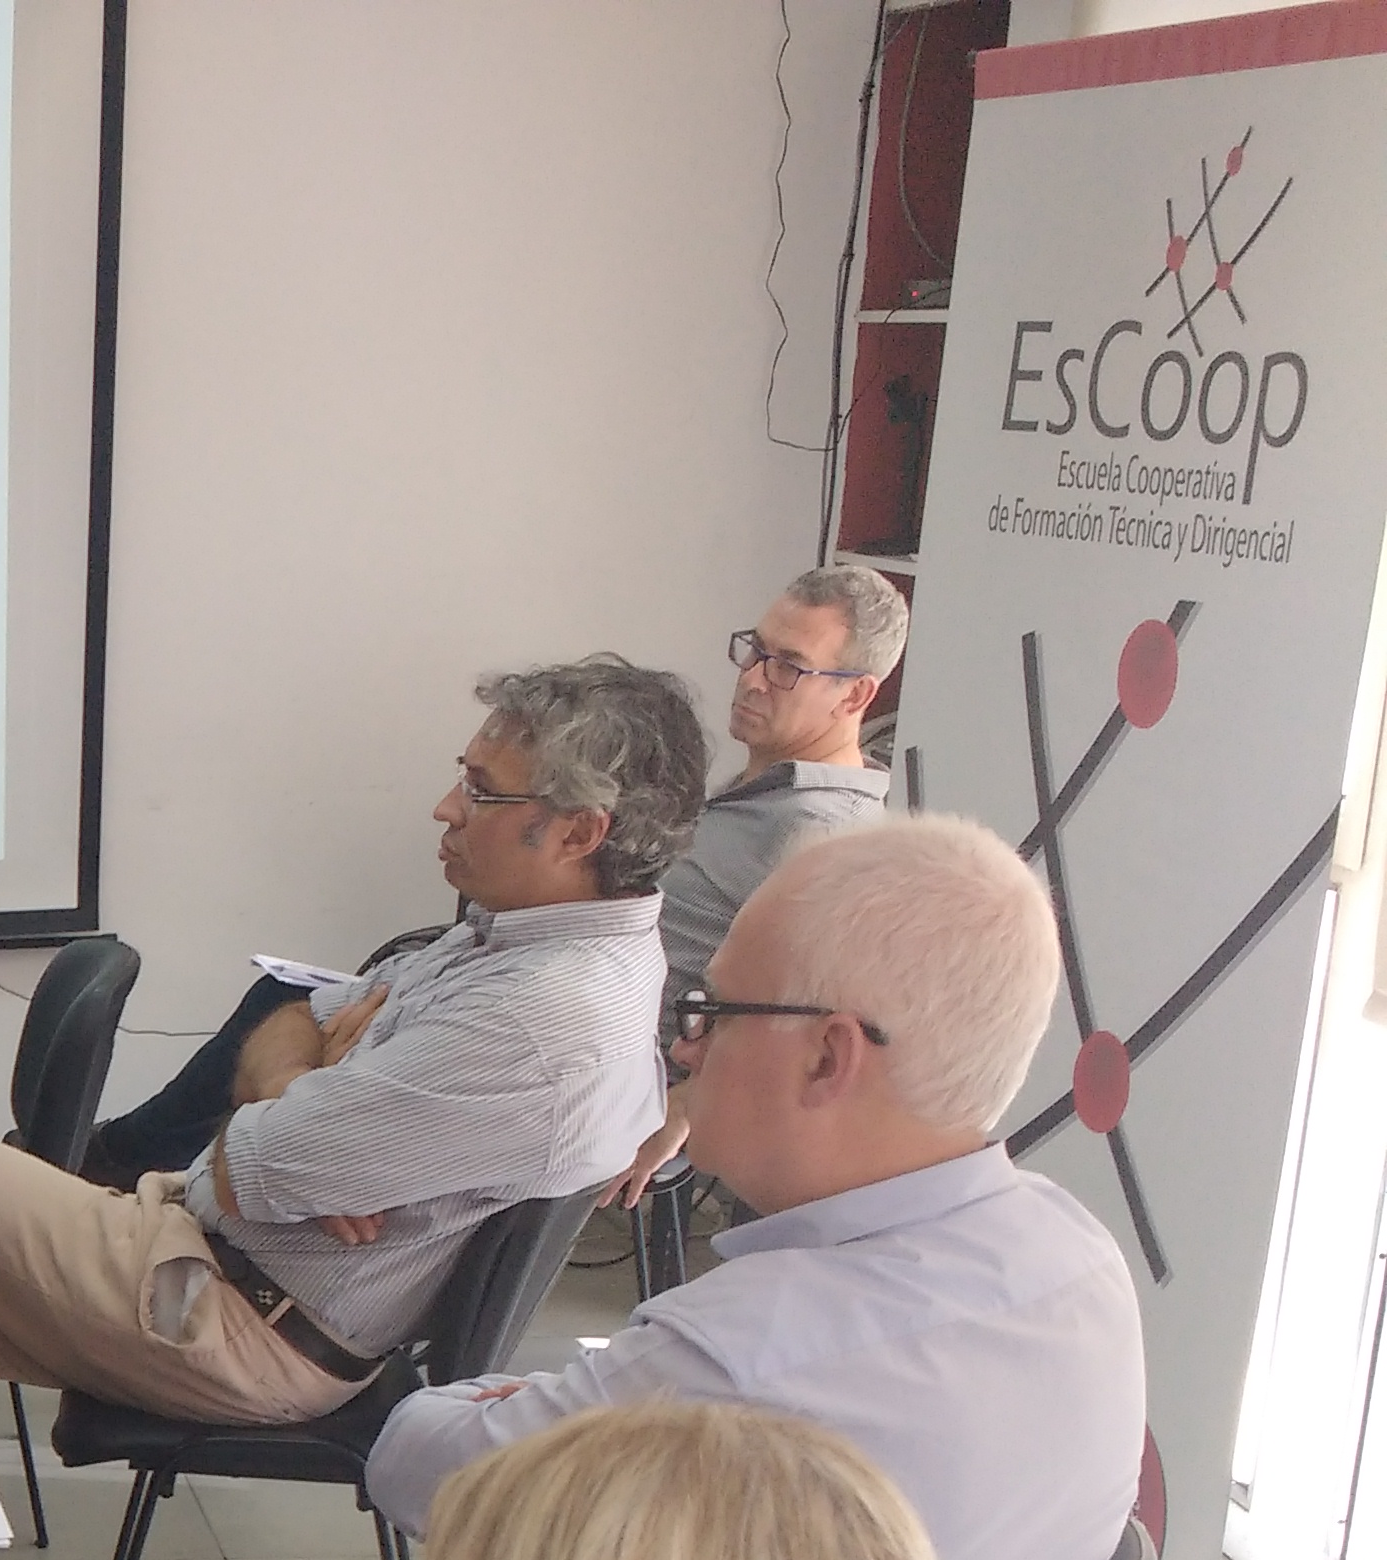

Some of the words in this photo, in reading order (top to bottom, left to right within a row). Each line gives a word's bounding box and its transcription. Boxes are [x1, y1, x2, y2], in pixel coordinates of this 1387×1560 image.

[1002, 320, 1308, 505] EsCoop
[1057, 451, 1122, 494] Escuela
[1126, 455, 1235, 507] Cooperativa
[988, 496, 1009, 533] de
[1012, 498, 1103, 543] Formación
[1108, 506, 1173, 549] Técnica
[1174, 522, 1188, 563] y
[1190, 514, 1295, 567] Dirigencial
